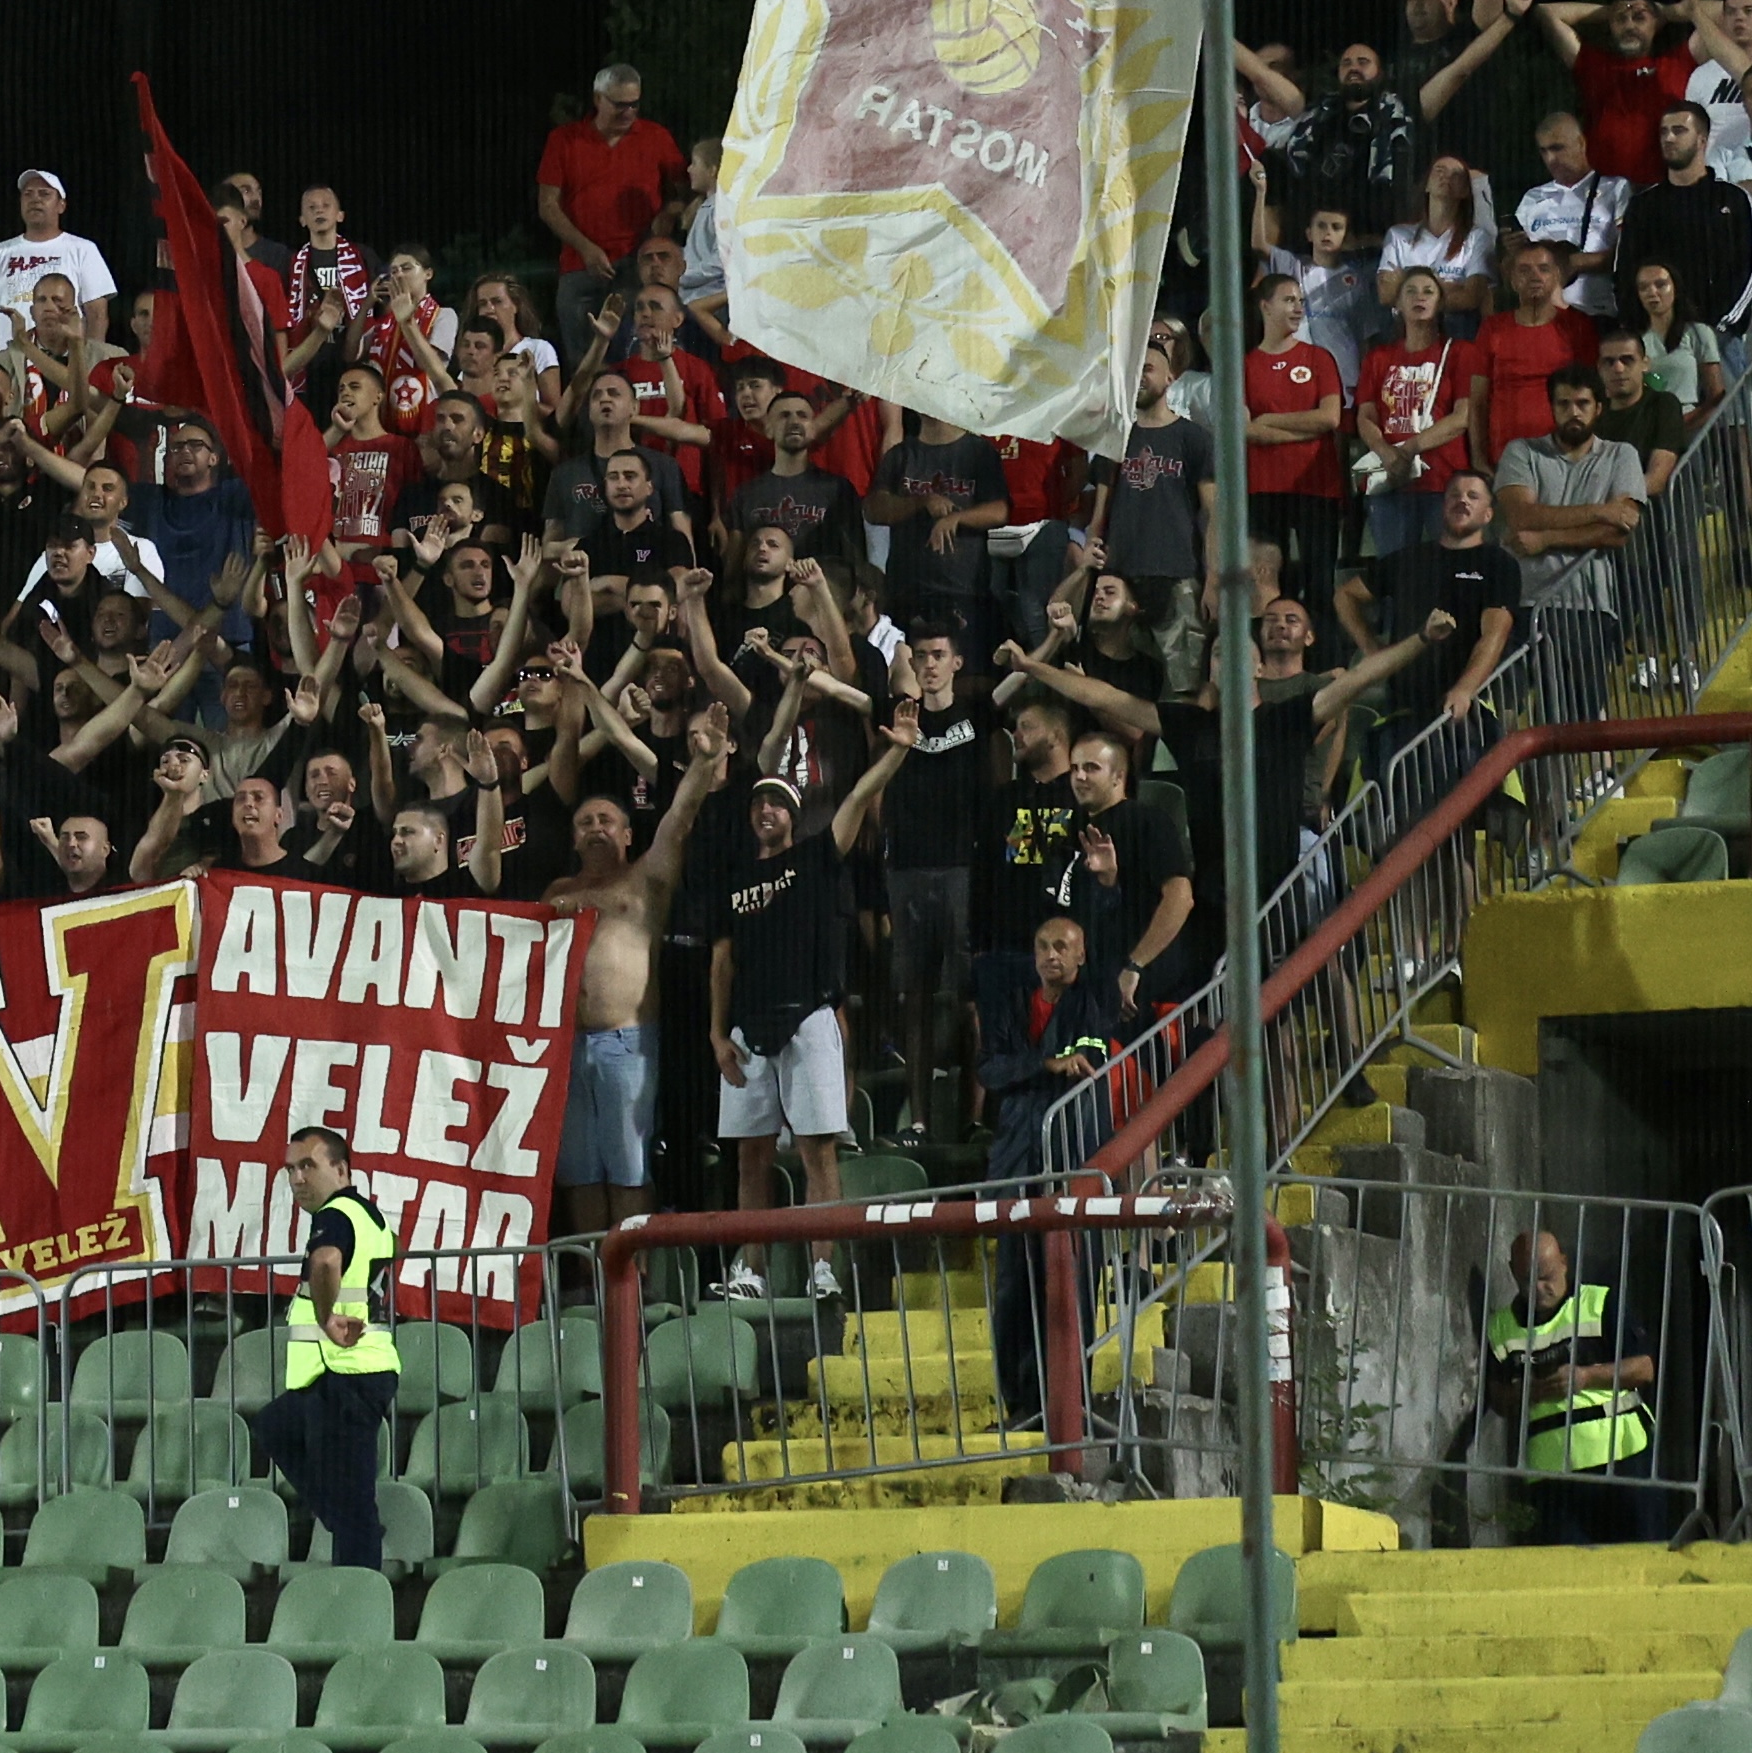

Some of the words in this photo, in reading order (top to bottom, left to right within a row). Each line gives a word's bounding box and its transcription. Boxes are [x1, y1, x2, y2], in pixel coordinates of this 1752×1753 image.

[210, 884, 574, 1029] AVANTI
[205, 1032, 550, 1178] VELEŽ
[187, 1158, 536, 1304] MOTAR
